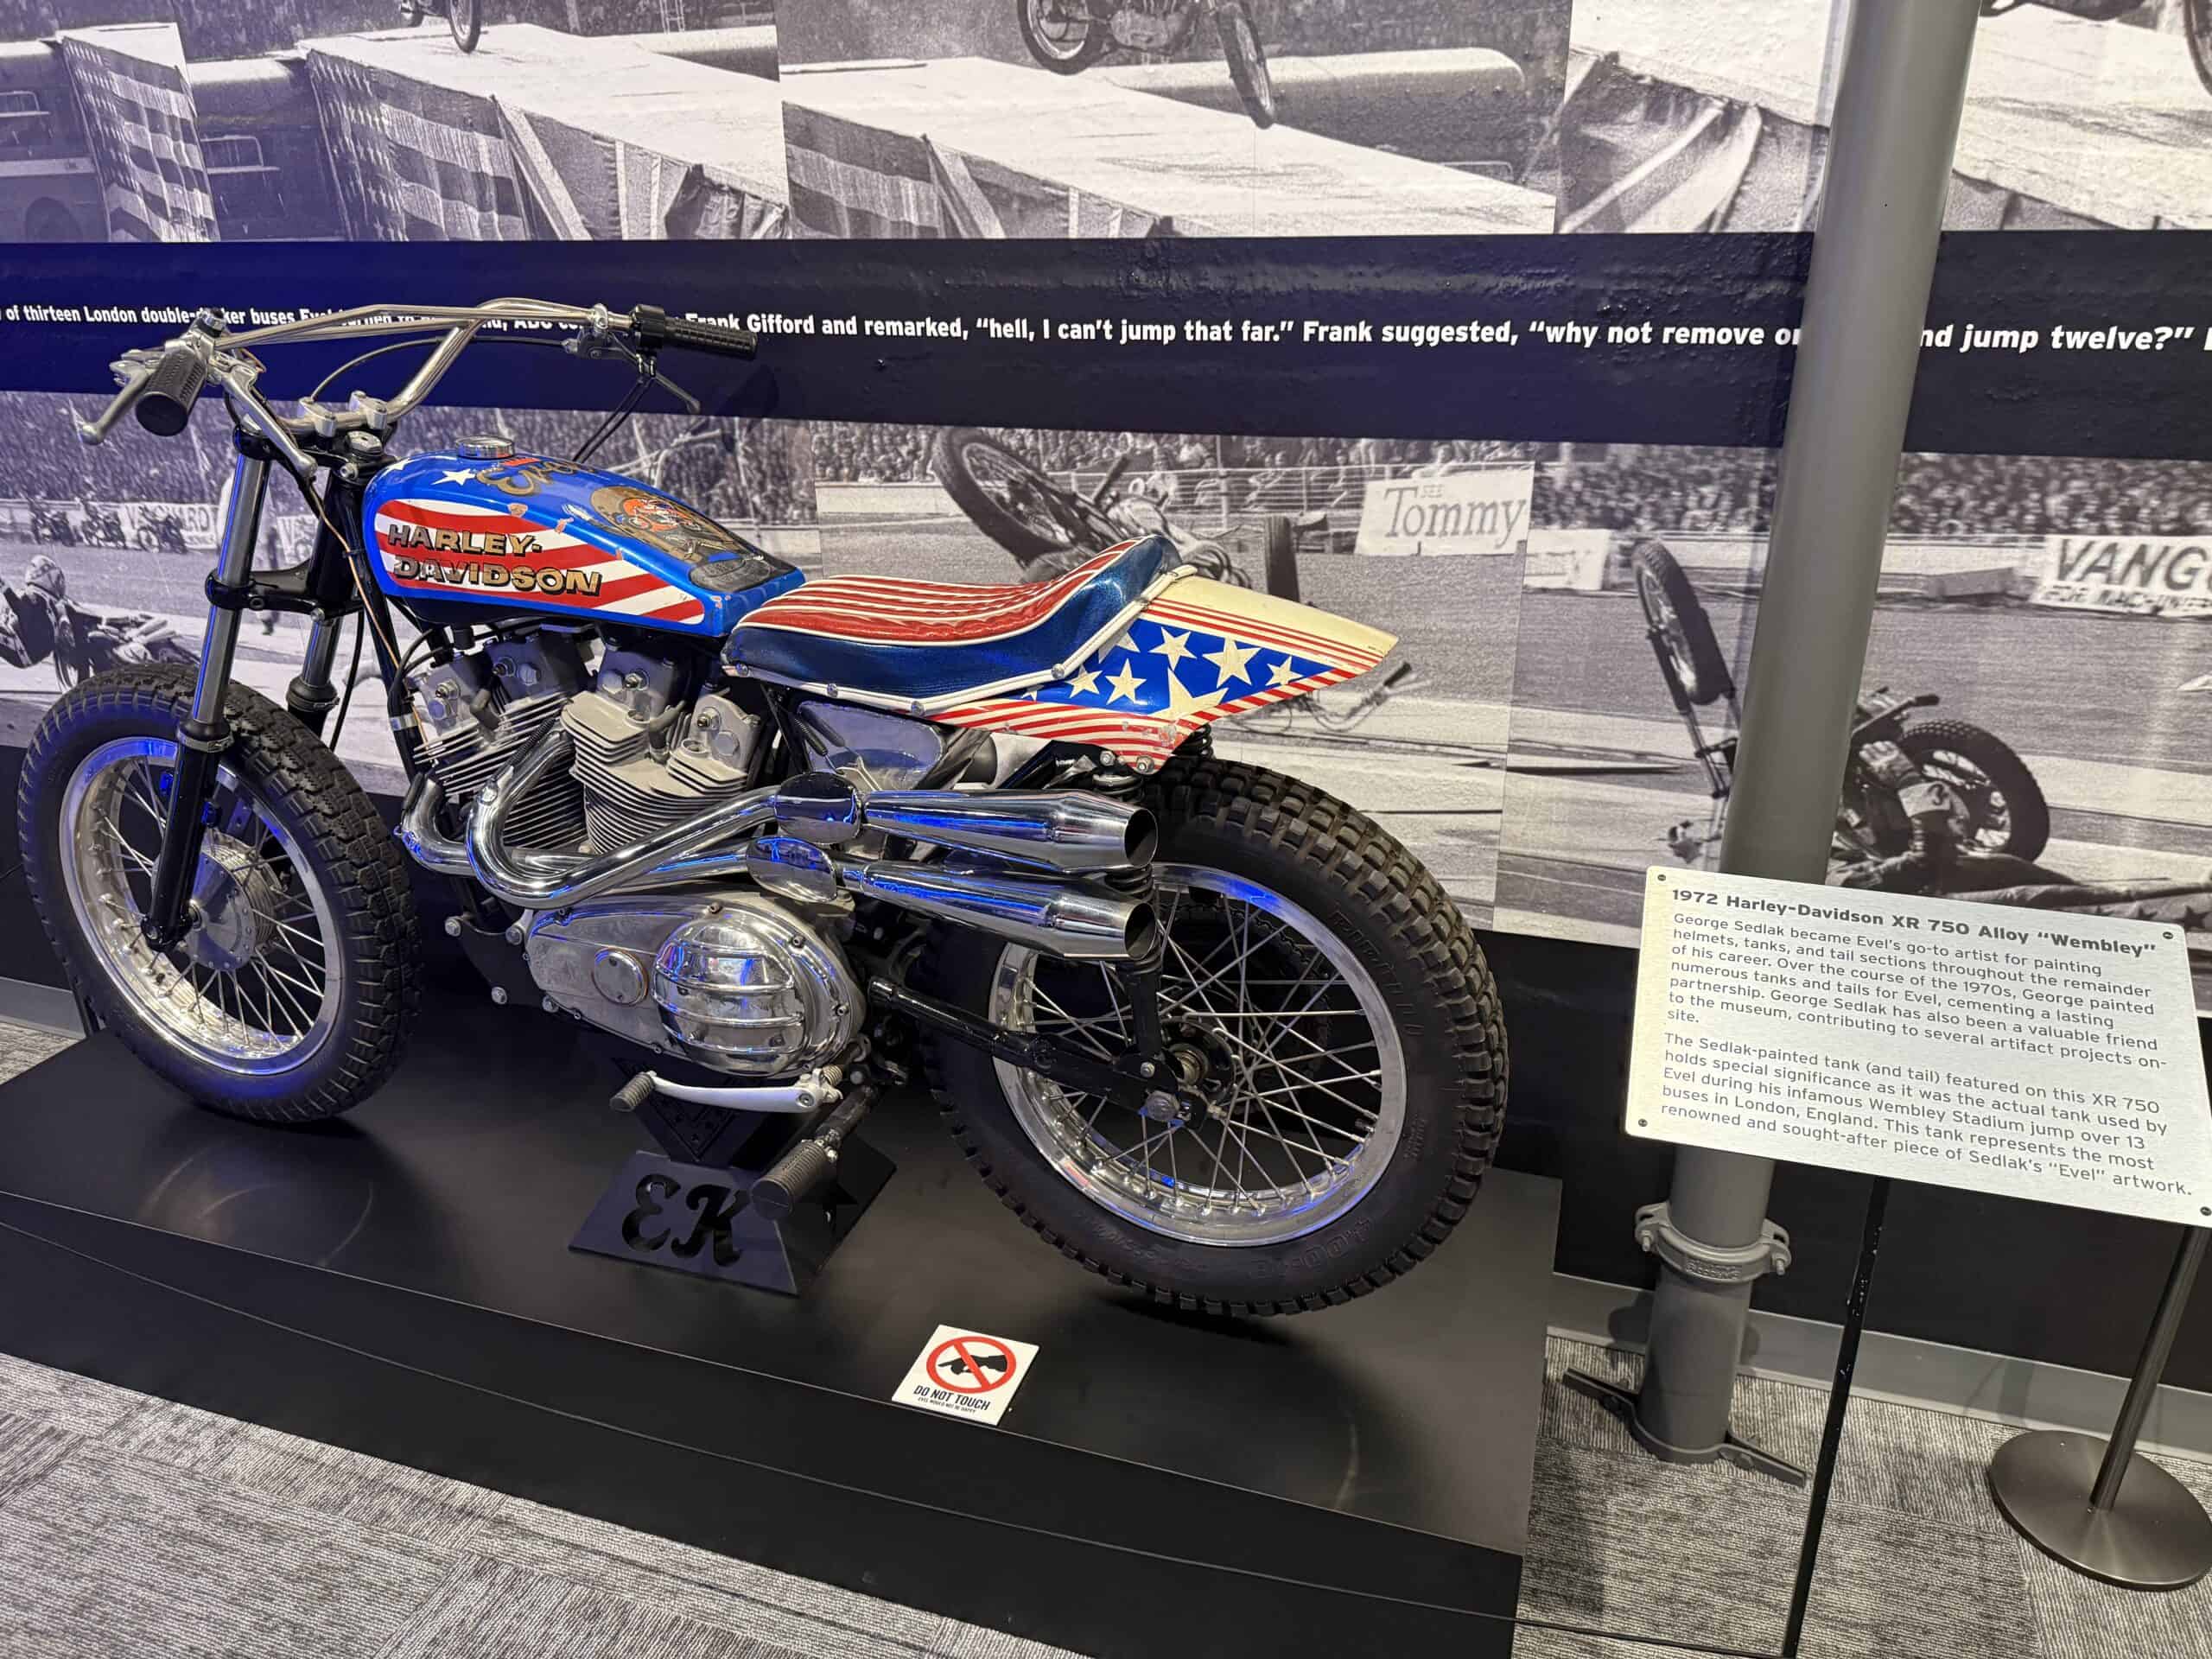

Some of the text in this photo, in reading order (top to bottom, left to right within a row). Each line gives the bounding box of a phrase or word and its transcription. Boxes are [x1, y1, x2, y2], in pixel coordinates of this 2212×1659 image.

[5, 304, 20, 321] of
[22, 304, 81, 322] thirteen
[84, 306, 138, 323] London
[250, 308, 296, 325] buses
[747, 313, 815, 334] Gifford
[822, 315, 858, 335] and
[864, 316, 969, 340] remarked,
[976, 317, 1035, 342] “hell,
[1043, 318, 1050, 340] I
[1058, 319, 1113, 340] can’t
[1119, 319, 1176, 346] jump
[1183, 320, 1233, 341] that
[1241, 320, 1294, 342] far.”
[1303, 320, 1373, 342] Frank
[1381, 320, 1518, 347] suggested,
[1529, 321, 1599, 348] “why
[1607, 321, 1653, 344] not
[1662, 327, 1764, 346] remove
[1920, 324, 1954, 347] nd
[1959, 323, 2039, 353] jump
[2050, 325, 2196, 351] twelve?”
[388, 523, 543, 557] HARLEY-
[1383, 485, 1527, 550] Tommy
[394, 554, 602, 596] DAVIDSON
[2057, 538, 2212, 592] VANG
[1672, 889, 2156, 957] 1972 Harley-Davidson XR 750 Alloy “Wembley”
[1674, 912, 2101, 977] George Sedlak became Evel's go-to artist for painting
[1671, 962, 2113, 1029] numerous tanks and tails for Evel, cementing a lasting
[1672, 944, 2154, 1014] of his career. Over the course of the 1970s, George painted
[1673, 928, 2152, 997] helmets, tanks, and tail sections throughout the remainder
[1667, 1008, 1699, 1023] site.
[1669, 977, 2158, 1050] partnership. George Sedlak has also been a valuable friend
[1669, 991, 2166, 1069] to the museum, contributing to several artifact projects on-
[1664, 1032, 2159, 1113] The Sedlak-painted tank (and tail) featured on this XR 750
[1665, 1050, 2167, 1135] holds special significance as it was the actual tank used by
[1662, 1084, 2154, 1170] buses in London, England. This tank represents the most
[1663, 1067, 2145, 1149] Evel during his infamous Wembley Stadium jump over 13
[1661, 1105, 2191, 1195] renowned and sought-after piece of Sedlak's “Evel” artwork.
[913, 1385, 991, 1411] DO NOT TOUCH
